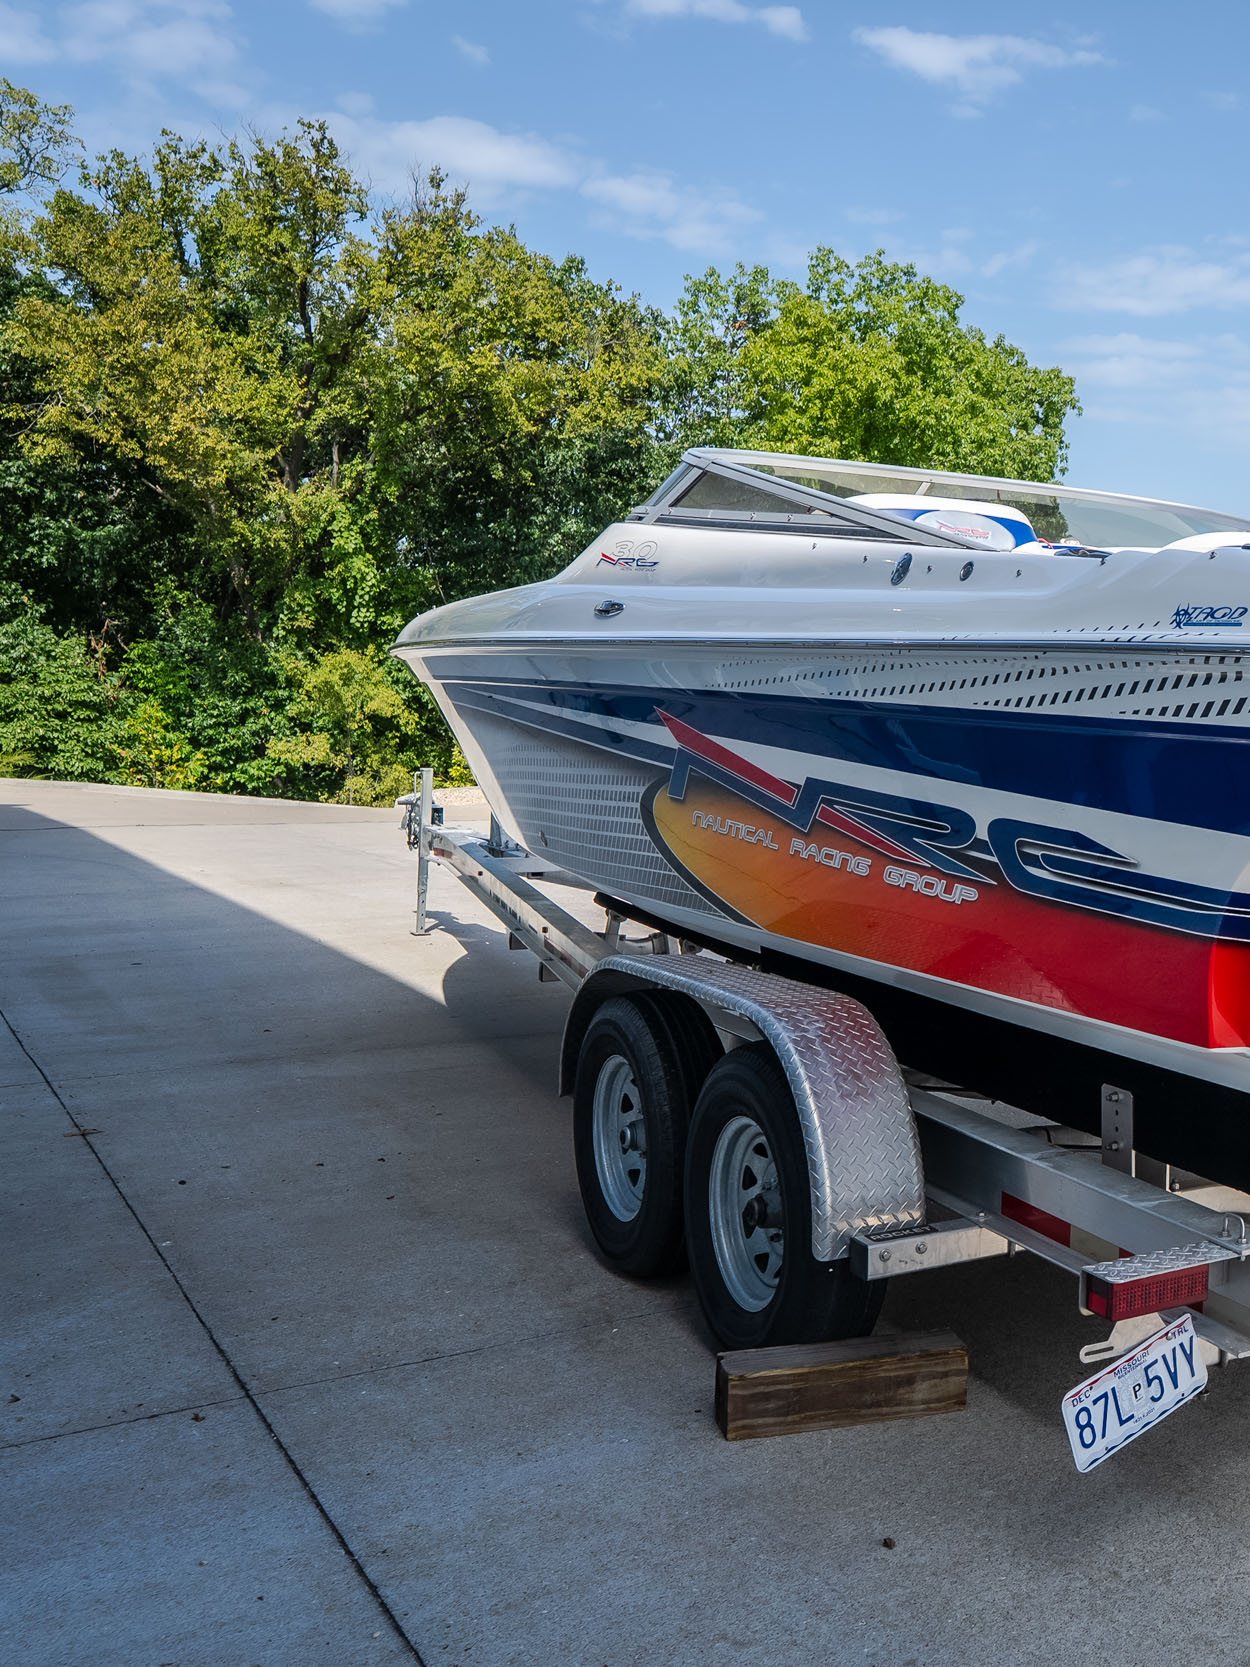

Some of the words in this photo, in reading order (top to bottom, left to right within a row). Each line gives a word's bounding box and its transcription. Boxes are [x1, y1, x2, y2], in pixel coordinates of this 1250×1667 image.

[595, 552, 660, 567] NRG
[611, 540, 658, 560] 30
[691, 809, 779, 851] NAUTICAL
[789, 838, 872, 876] RACING
[883, 865, 979, 905] GROUP
[870, 1226, 932, 1241] ROCKET
[1071, 1390, 1091, 1408] DEC
[1172, 1326, 1190, 1340] TRL
[1113, 1350, 1150, 1377] MISSOURI
[1075, 1386, 1135, 1449] 87L
[1132, 1382, 1142, 1400] P
[1143, 1335, 1196, 1403] 5VY
